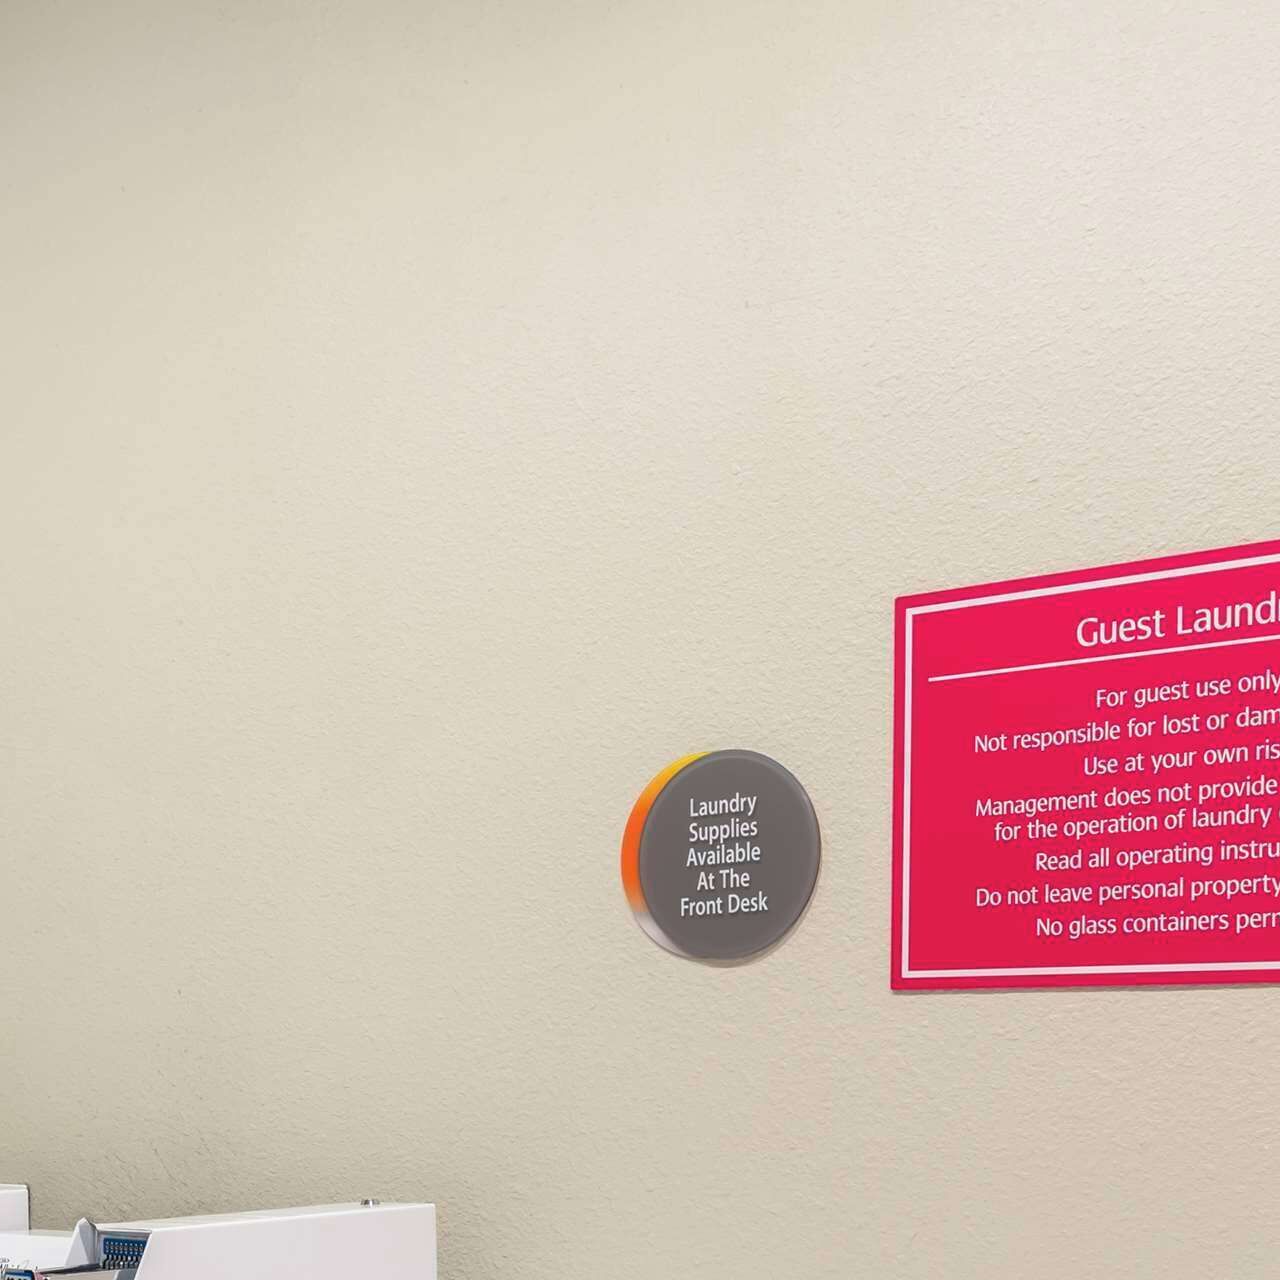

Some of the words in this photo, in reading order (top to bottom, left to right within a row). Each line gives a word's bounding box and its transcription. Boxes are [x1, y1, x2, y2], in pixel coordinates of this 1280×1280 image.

[1077, 610, 1165, 646] Guest
[1096, 689, 1127, 707] For
[1134, 681, 1189, 708] guest
[1196, 679, 1231, 697] use
[975, 734, 1007, 752] Not
[1014, 721, 1120, 751] responsible
[1127, 718, 1156, 737] for
[1163, 714, 1200, 734] lost
[1207, 714, 1229, 730] or
[1085, 757, 1118, 775] Use
[1125, 753, 1144, 771] at
[1151, 751, 1197, 773] your
[1204, 747, 1248, 765] own
[690, 792, 757, 816] Laundry
[976, 791, 1098, 817] Management
[1104, 787, 1151, 806] does
[1158, 783, 1192, 802] not
[1199, 775, 1277, 804] provide
[689, 818, 757, 844] Supplies
[995, 822, 1021, 840] for
[1027, 819, 1057, 838] the
[1064, 812, 1157, 840] operation
[1164, 808, 1186, 829] of
[1193, 804, 1272, 827] laundry
[686, 843, 760, 866] Available
[1036, 849, 1082, 870] Read
[1089, 848, 1109, 868] all
[1116, 842, 1213, 870] operating
[697, 872, 715, 890] At
[719, 868, 750, 888] The
[977, 889, 1001, 906] Do
[1008, 887, 1038, 904] not
[1045, 884, 1092, 903] leave
[1099, 877, 1183, 905] personal
[681, 897, 722, 916] Front
[728, 891, 768, 913] Desk
[1037, 918, 1063, 936] No
[1069, 915, 1117, 939] glass
[1123, 911, 1229, 932] containers
